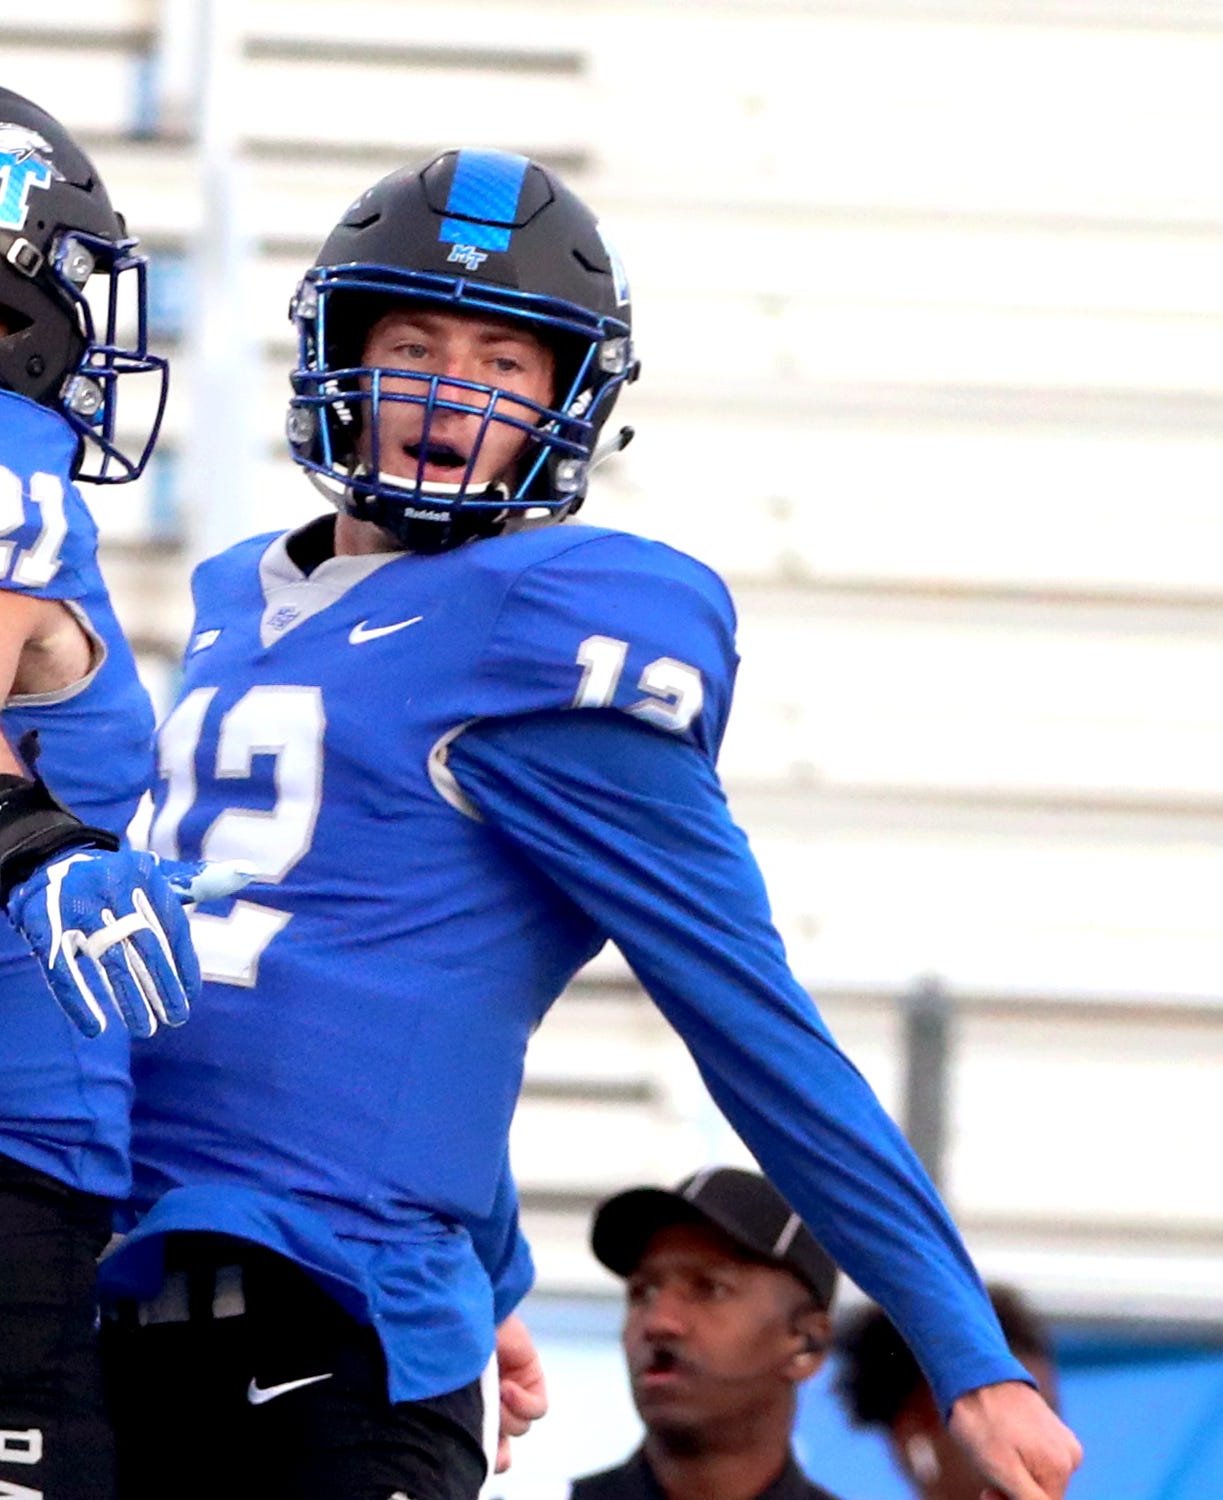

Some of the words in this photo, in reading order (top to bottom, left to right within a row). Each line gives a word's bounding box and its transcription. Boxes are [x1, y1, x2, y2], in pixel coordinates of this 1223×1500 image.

[446, 244, 489, 271] MT
[574, 634, 704, 732] 12
[148, 684, 328, 988] 12
